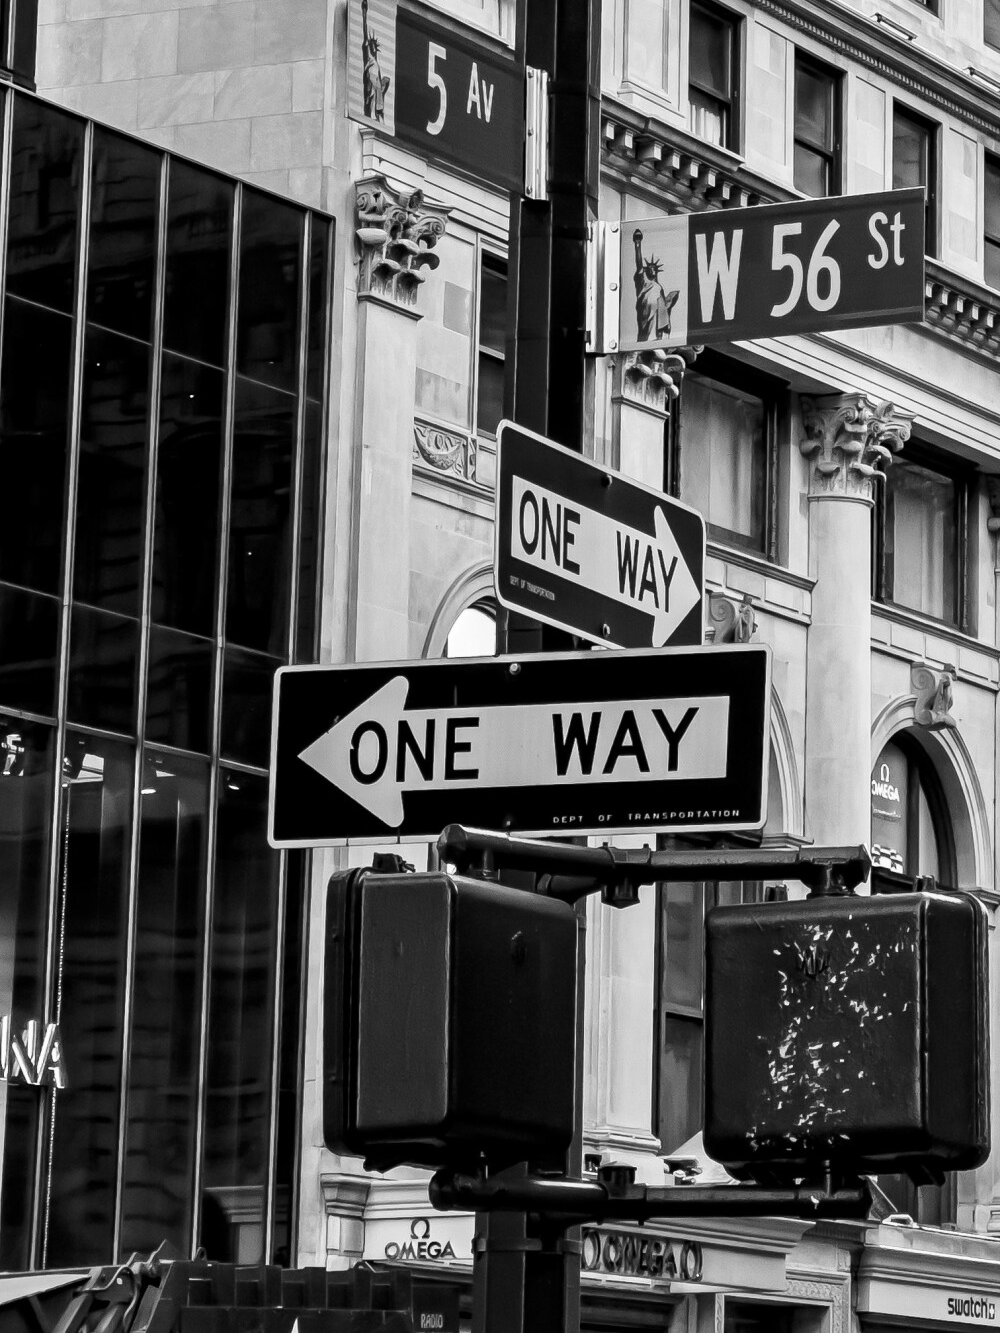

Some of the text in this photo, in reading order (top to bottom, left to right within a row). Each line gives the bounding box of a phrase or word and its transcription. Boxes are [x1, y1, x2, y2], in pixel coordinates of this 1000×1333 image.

[426, 41, 448, 135] 5
[694, 211, 905, 323] W 56 St
[519, 489, 679, 613] ONE WAY
[349, 707, 700, 785] ONE WAY
[553, 809, 740, 823] DEPT OF TRANSPORTATION
[871, 779, 900, 803] OMEGA
[384, 1240, 457, 1262] OMEGA
[947, 1296, 988, 1319] swatch
